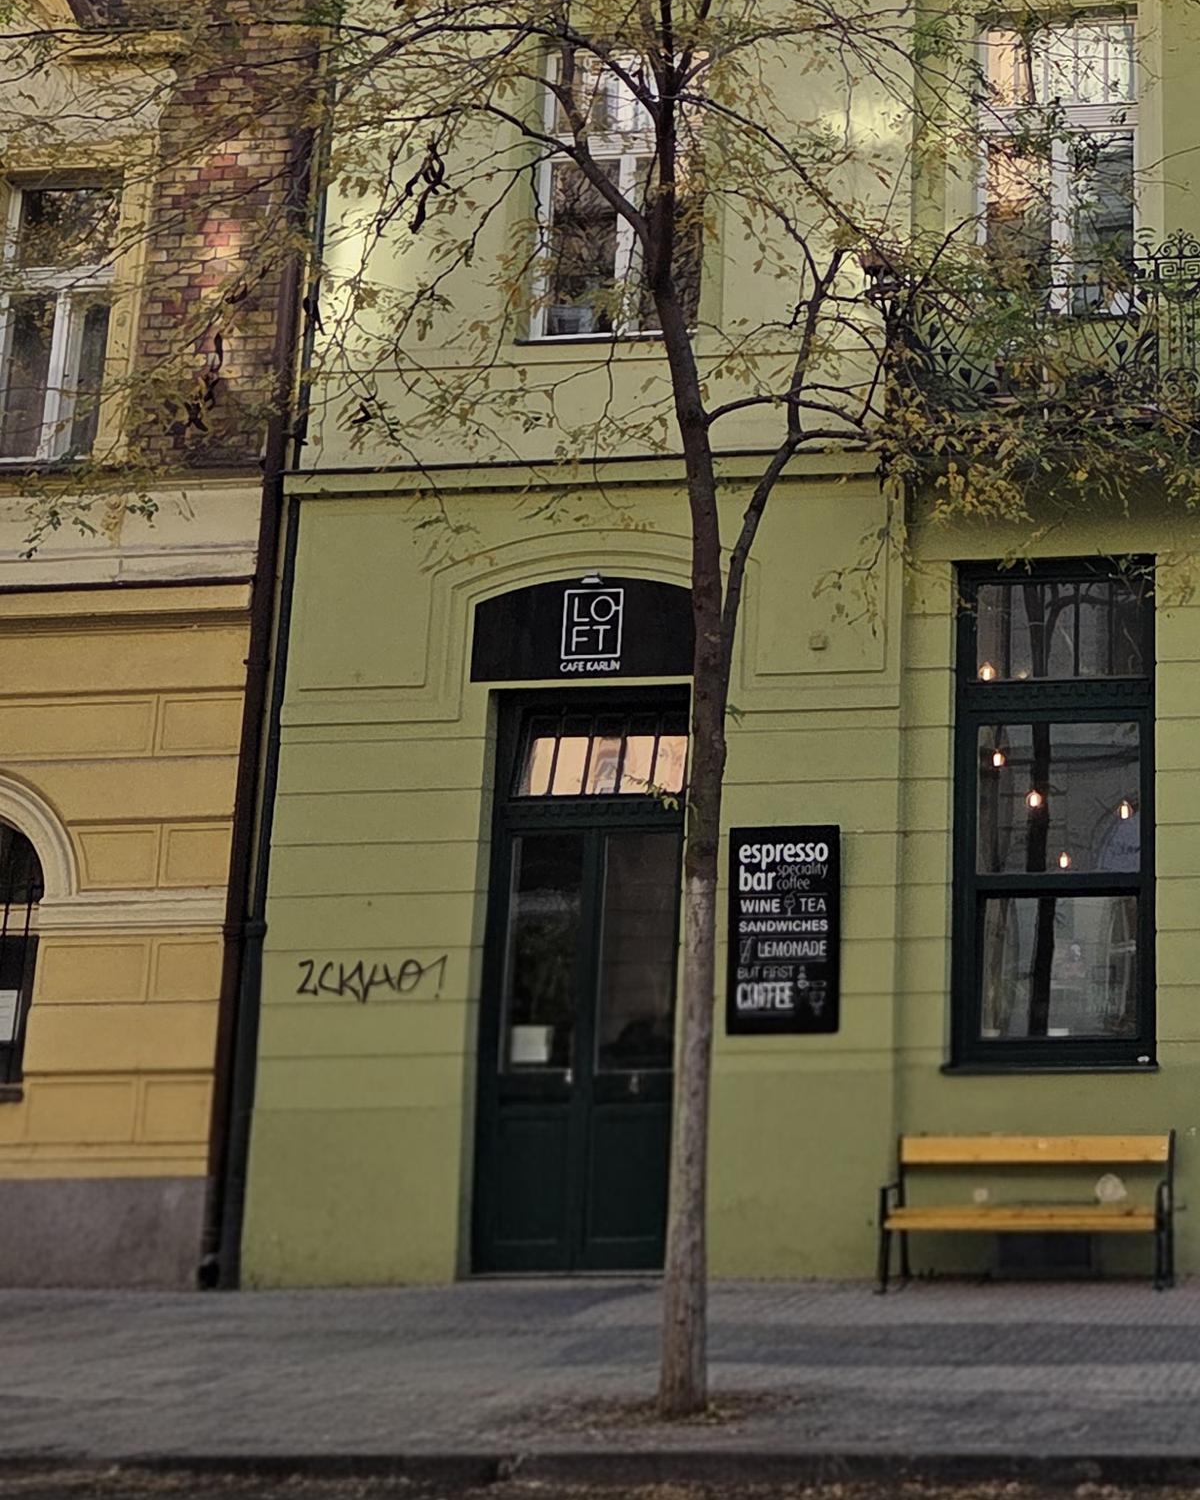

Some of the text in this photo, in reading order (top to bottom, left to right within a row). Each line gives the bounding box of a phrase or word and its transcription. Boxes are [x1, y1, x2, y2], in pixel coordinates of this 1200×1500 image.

[560, 661, 585, 672] CAFE
[738, 842, 829, 870] espresso
[738, 865, 776, 891] bar
[776, 862, 828, 878] speciality
[776, 877, 811, 891] coffee
[740, 897, 827, 913] WINE TEA
[738, 919, 829, 933] SANDWICHES
[757, 940, 827, 958] LEMONADE
[737, 964, 794, 980] BUT FIRST
[736, 981, 795, 1010] COFFEE
